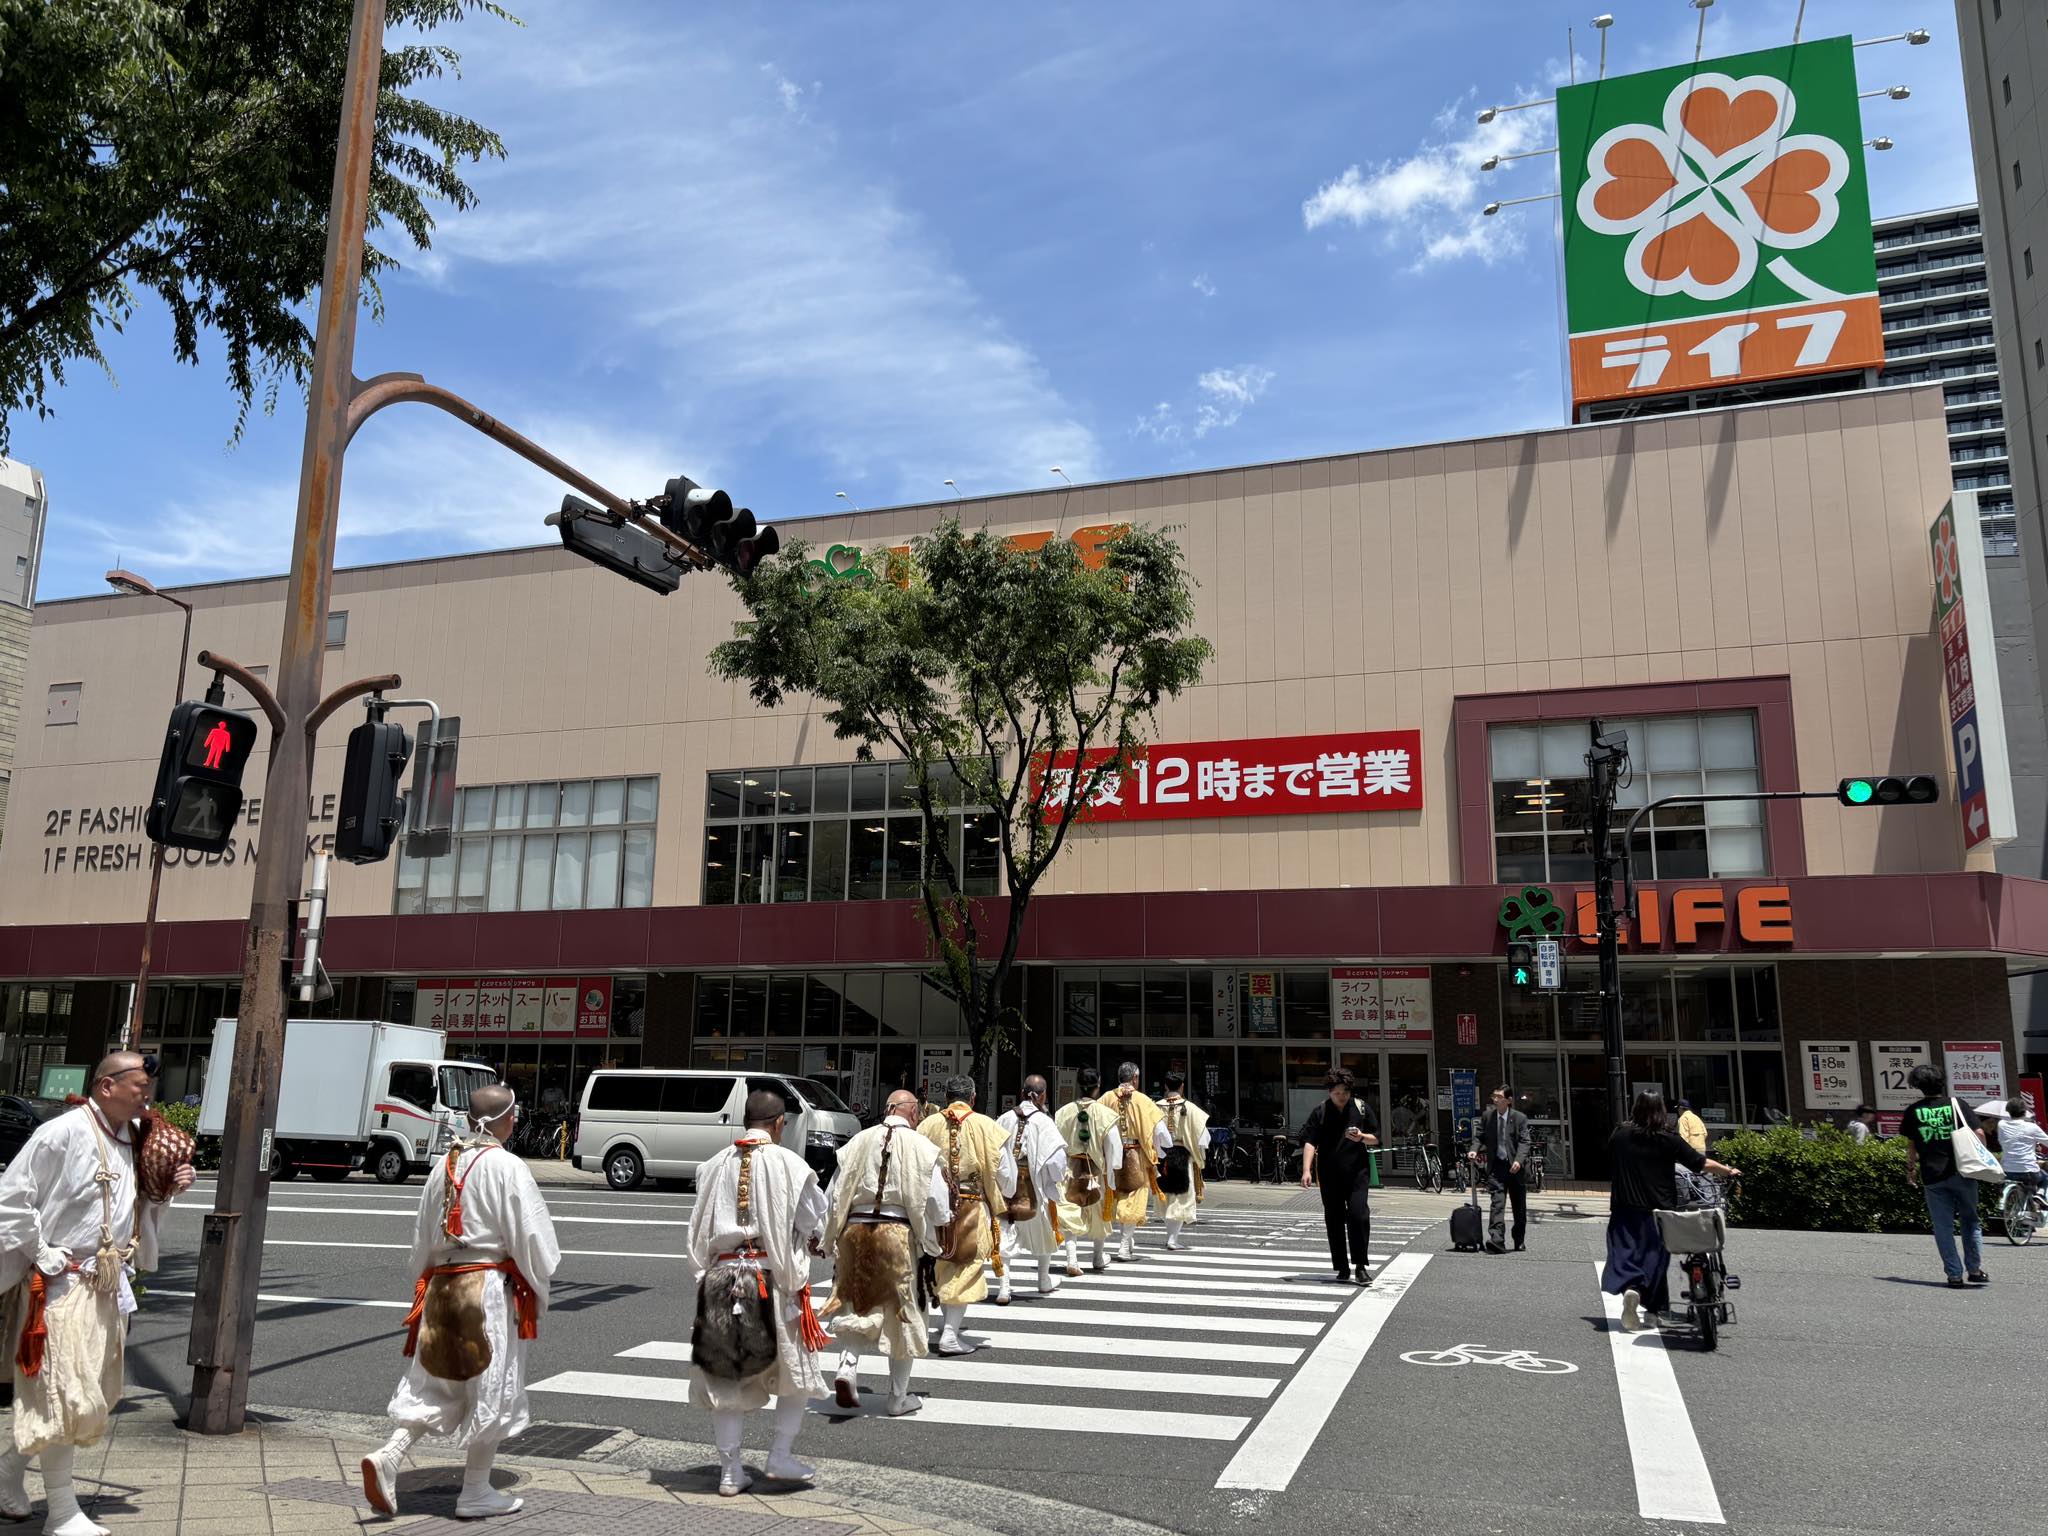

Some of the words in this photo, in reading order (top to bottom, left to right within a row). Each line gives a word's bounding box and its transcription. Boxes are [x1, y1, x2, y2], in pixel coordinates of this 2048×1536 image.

[1602, 310, 1847, 389] ライフ
[1957, 723, 1977, 790] P
[44, 809, 72, 837] 2F
[43, 845, 67, 874] 1F
[74, 843, 142, 873] FRESH
[1576, 886, 1794, 945] LIFE
[1251, 974, 1272, 995] 薬
[1340, 982, 1371, 993] ライフ
[433, 991, 571, 1007] ライフネットスーパー
[1341, 995, 1416, 1007] ネットスーパー
[430, 1013, 507, 1029] 会員募集中
[1341, 1009, 1409, 1021] 会員募集中
[1889, 1057, 1915, 1068] 深夜
[1952, 1062, 1999, 1070] ネットスーパー
[1952, 1071, 2000, 1080] 会員募集中
